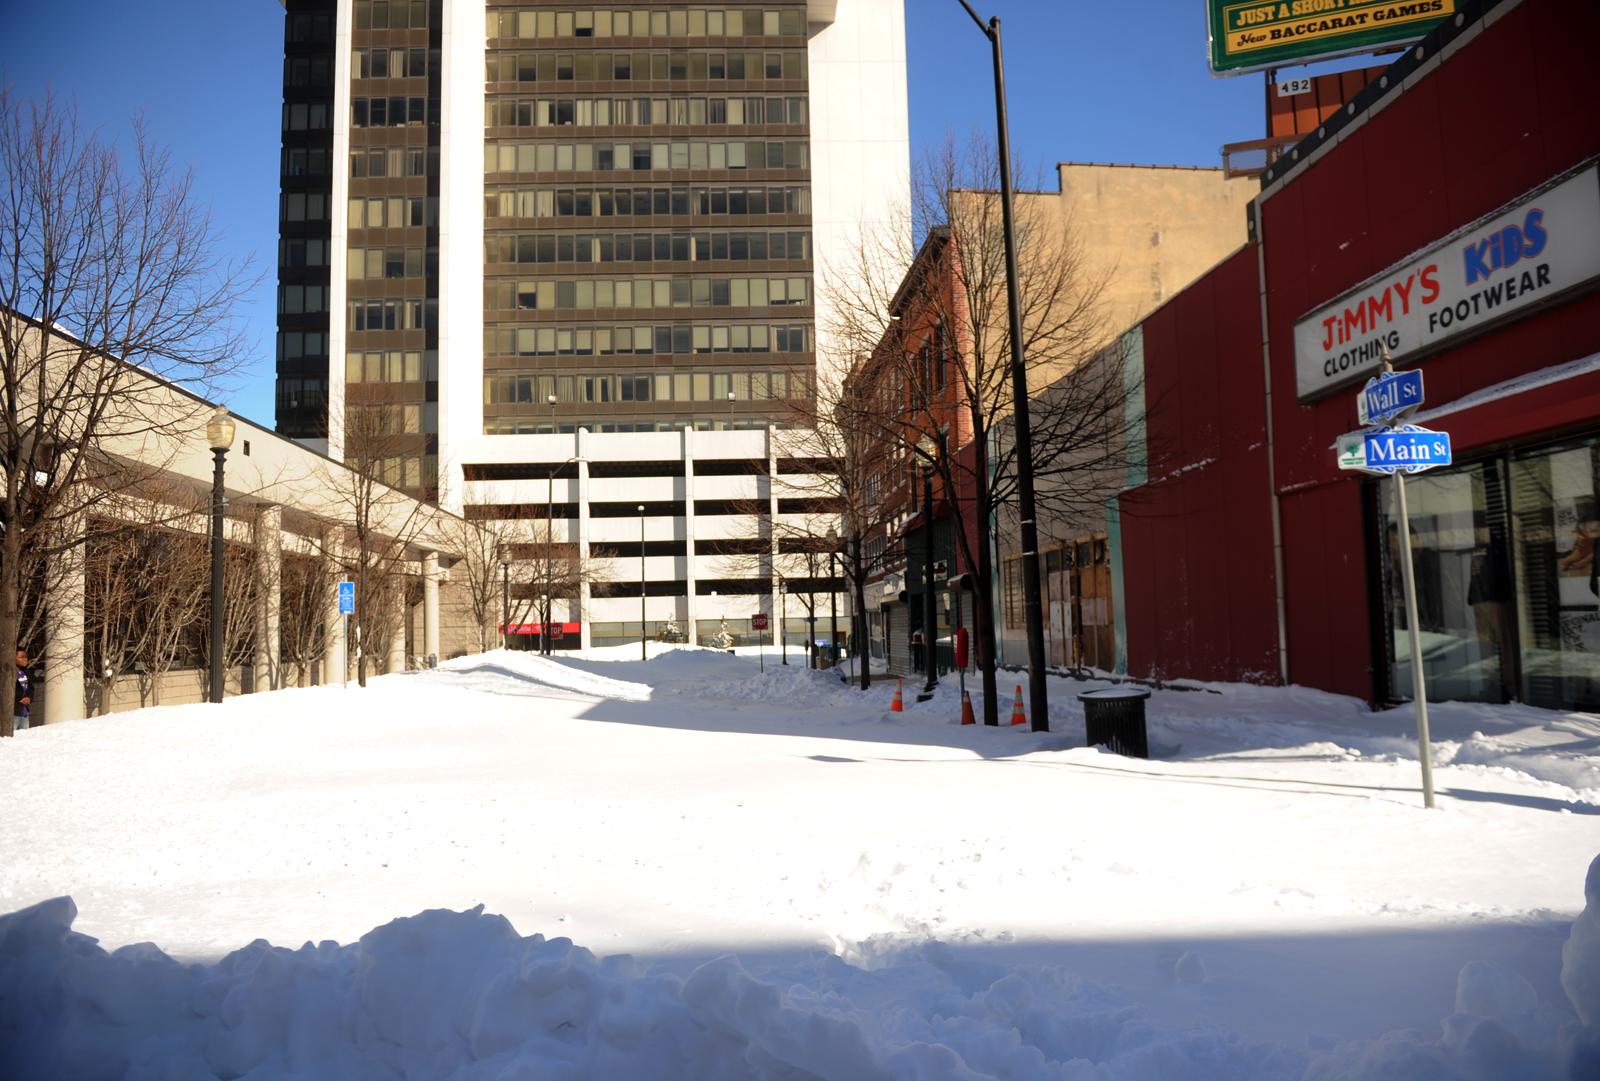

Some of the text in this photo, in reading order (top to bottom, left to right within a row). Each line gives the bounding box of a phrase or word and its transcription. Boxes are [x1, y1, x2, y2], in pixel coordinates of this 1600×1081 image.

[1237, 5, 1276, 26] JUST
[1279, 3, 1290, 18] A
[1237, 0, 1444, 47] New BACCARAT GAMES
[1281, 79, 1309, 93] 492
[1323, 263, 1551, 377] CLOTHING FOOTWEAR
[1368, 381, 1417, 414] Wall St
[1369, 438, 1447, 461] Main St
[752, 618, 767, 626] STOP
